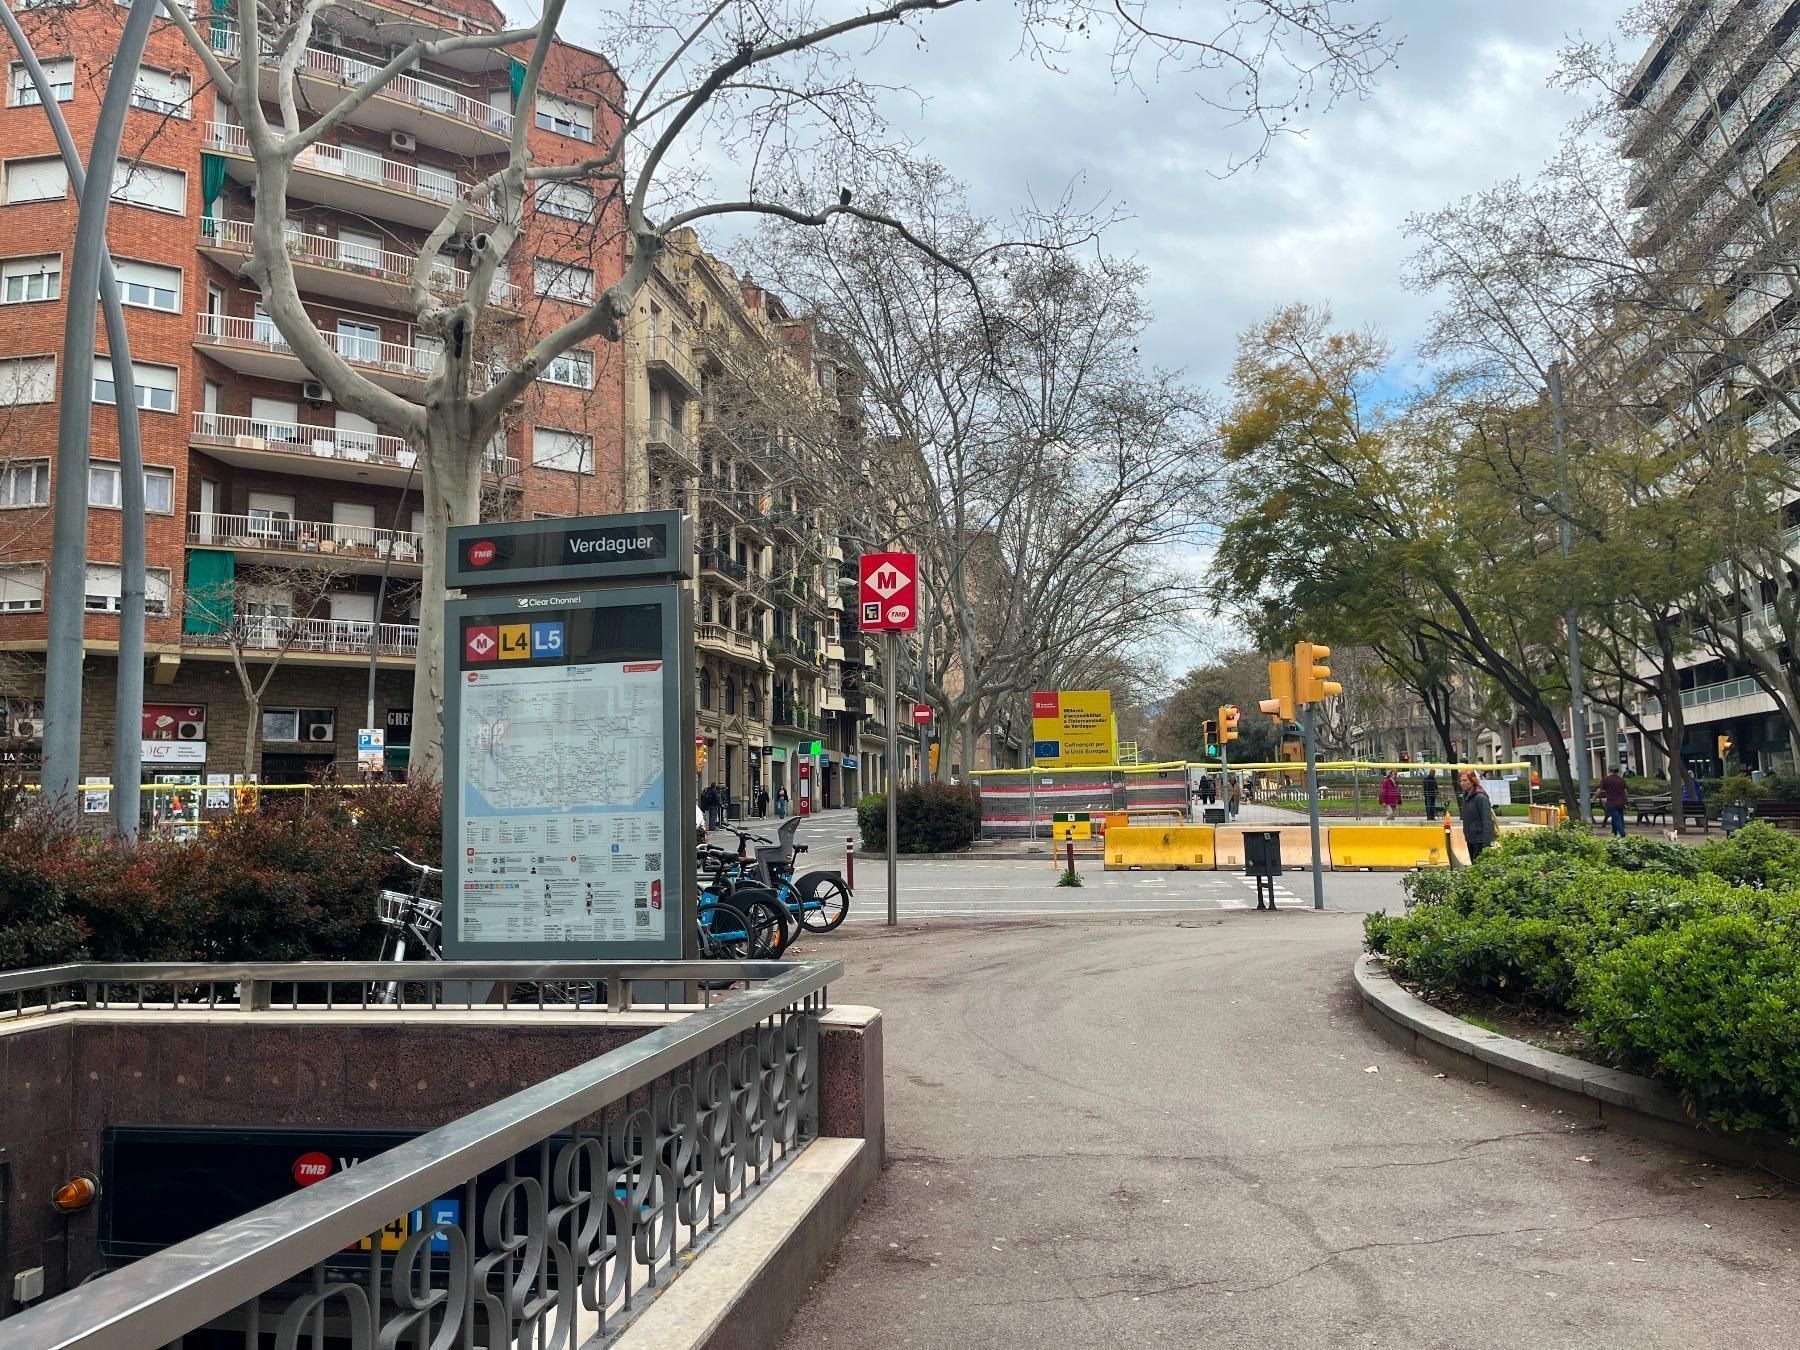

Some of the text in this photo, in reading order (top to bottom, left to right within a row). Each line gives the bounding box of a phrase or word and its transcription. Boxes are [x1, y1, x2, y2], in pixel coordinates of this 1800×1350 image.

[569, 536, 654, 554] Verdaguer
[474, 550, 492, 559] TMB
[877, 571, 897, 589] M
[529, 595, 581, 607] Clear Channel
[476, 630, 562, 652] M L4 L5
[300, 1164, 326, 1175] TMB
